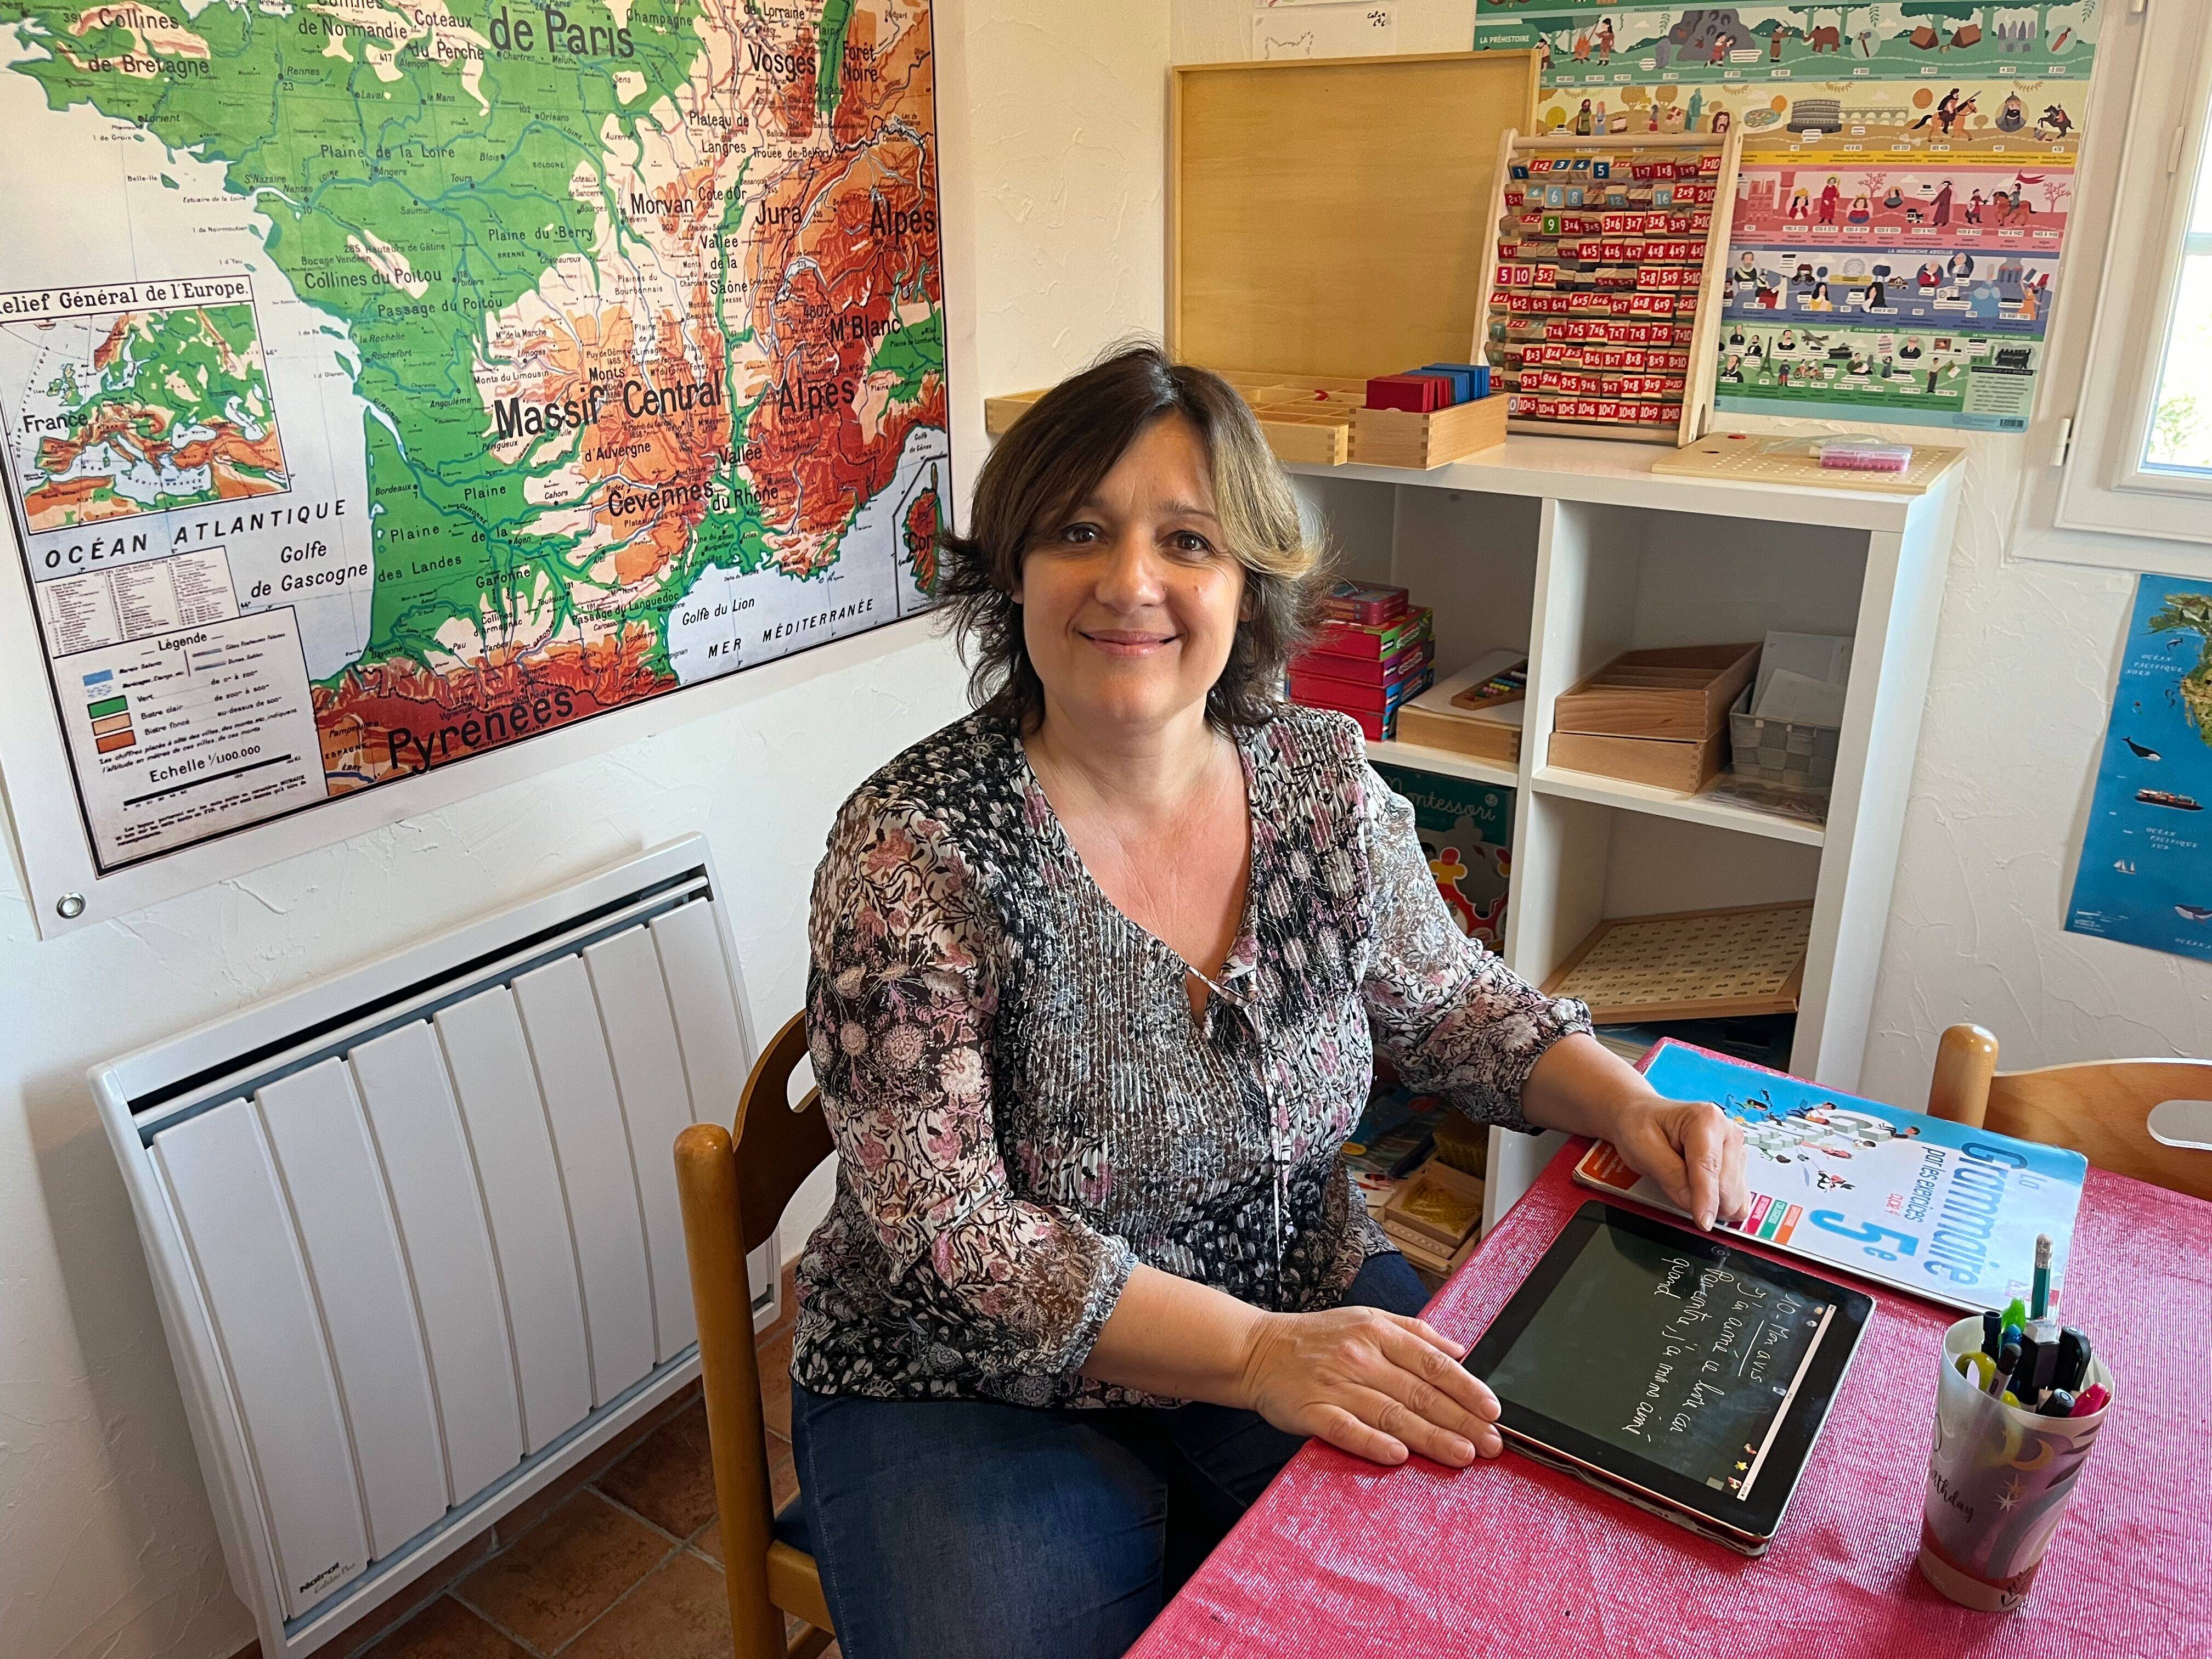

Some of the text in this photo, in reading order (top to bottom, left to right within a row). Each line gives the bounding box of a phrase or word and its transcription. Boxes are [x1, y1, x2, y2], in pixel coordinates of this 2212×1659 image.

[98, 8, 179, 29] Collines
[414, 9, 472, 29] Coteaux
[625, 8, 693, 27] Champagne
[763, 2, 805, 20] Lorraine
[298, 20, 408, 40] de Normandie
[490, 6, 635, 57] de Paris
[411, 41, 484, 62] du Perche
[843, 43, 874, 63] Forêt
[88, 55, 209, 81] de Bretagne
[287, 66, 320, 76] Rennes
[748, 43, 816, 82] Vosges
[843, 63, 877, 82] Noire
[145, 113, 180, 123] Lorient
[540, 112, 569, 122] Orléans
[690, 112, 749, 128] Plateau de
[321, 144, 455, 160] Plaine de la Loire
[702, 140, 746, 160] Langres
[753, 146, 782, 159] Trouée
[787, 146, 797, 157] de
[378, 167, 407, 178] Angers
[451, 174, 472, 183] Tours
[1598, 165, 1604, 176] 5
[1636, 167, 1650, 177] 1x7
[1657, 164, 1672, 176] 1x8
[283, 184, 313, 194] Nantes
[698, 187, 747, 202] Côte d'Or
[1551, 187, 1694, 205] 6 8 12 16 2x9
[400, 206, 432, 215] Saumur
[630, 193, 694, 215] Morvan
[755, 201, 803, 227] Jura
[870, 200, 935, 245] Alpes
[1548, 216, 1665, 231] 9 3x4 3x6 3x7 3x8
[488, 227, 593, 242] Plaine du Berry
[701, 235, 738, 250] Vallée
[1582, 245, 1685, 257] 4x5 4x6 4x8 4x9
[710, 257, 737, 270] de la
[304, 268, 442, 290] Collines du Poitou
[1501, 269, 1678, 284] 5 10 5x8 5x9
[710, 280, 748, 295] Saône
[0, 281, 249, 314] elief Général de l'Europe.
[1572, 295, 1670, 311] 6x5 6x9
[378, 298, 503, 319] Passage du Poitou
[804, 304, 828, 318] 4807
[851, 317, 901, 341] Blanc
[1569, 325, 1668, 338] 7x5 7x9
[371, 349, 412, 362] Rochefort
[589, 367, 625, 382] Monts
[1562, 377, 1576, 389] 9x5
[430, 397, 471, 409] Angoulême
[494, 389, 603, 440] Massif
[623, 380, 722, 419] Central
[778, 382, 855, 420] Alpes
[1599, 404, 1616, 415] 10x7
[23, 410, 88, 433] France
[585, 443, 651, 464] d'Auvergne
[719, 447, 763, 465] Vallée
[375, 484, 411, 495] Bordeaux
[464, 484, 506, 501] Plaine
[607, 480, 714, 518] Cévennes
[713, 484, 778, 511] du Rhône
[45, 499, 347, 568] OCÉAN ATLANTIQUE
[390, 525, 440, 543] Plaine
[471, 526, 508, 543] de la
[280, 541, 327, 564] Golfe
[378, 555, 462, 582] des Landes
[476, 567, 531, 589] Garonne
[251, 562, 368, 599] de Gascogne
[572, 608, 614, 628] Passage
[629, 591, 680, 613] Languedoc
[682, 596, 754, 626] Golfe du Lion
[709, 599, 874, 658] MER MÉDITERRANÉE
[159, 632, 207, 651] Légende
[453, 642, 466, 651] Pau
[387, 692, 574, 775] Pyrénées
[150, 758, 205, 783] Echelle
[1904, 1146, 1946, 1223] par les exercices
[2020, 1173, 2047, 1190] La
[1923, 1142, 2028, 1285] Grammaire
[1654, 1258, 1689, 1299] quand
[1750, 1350, 1770, 1383] avis
